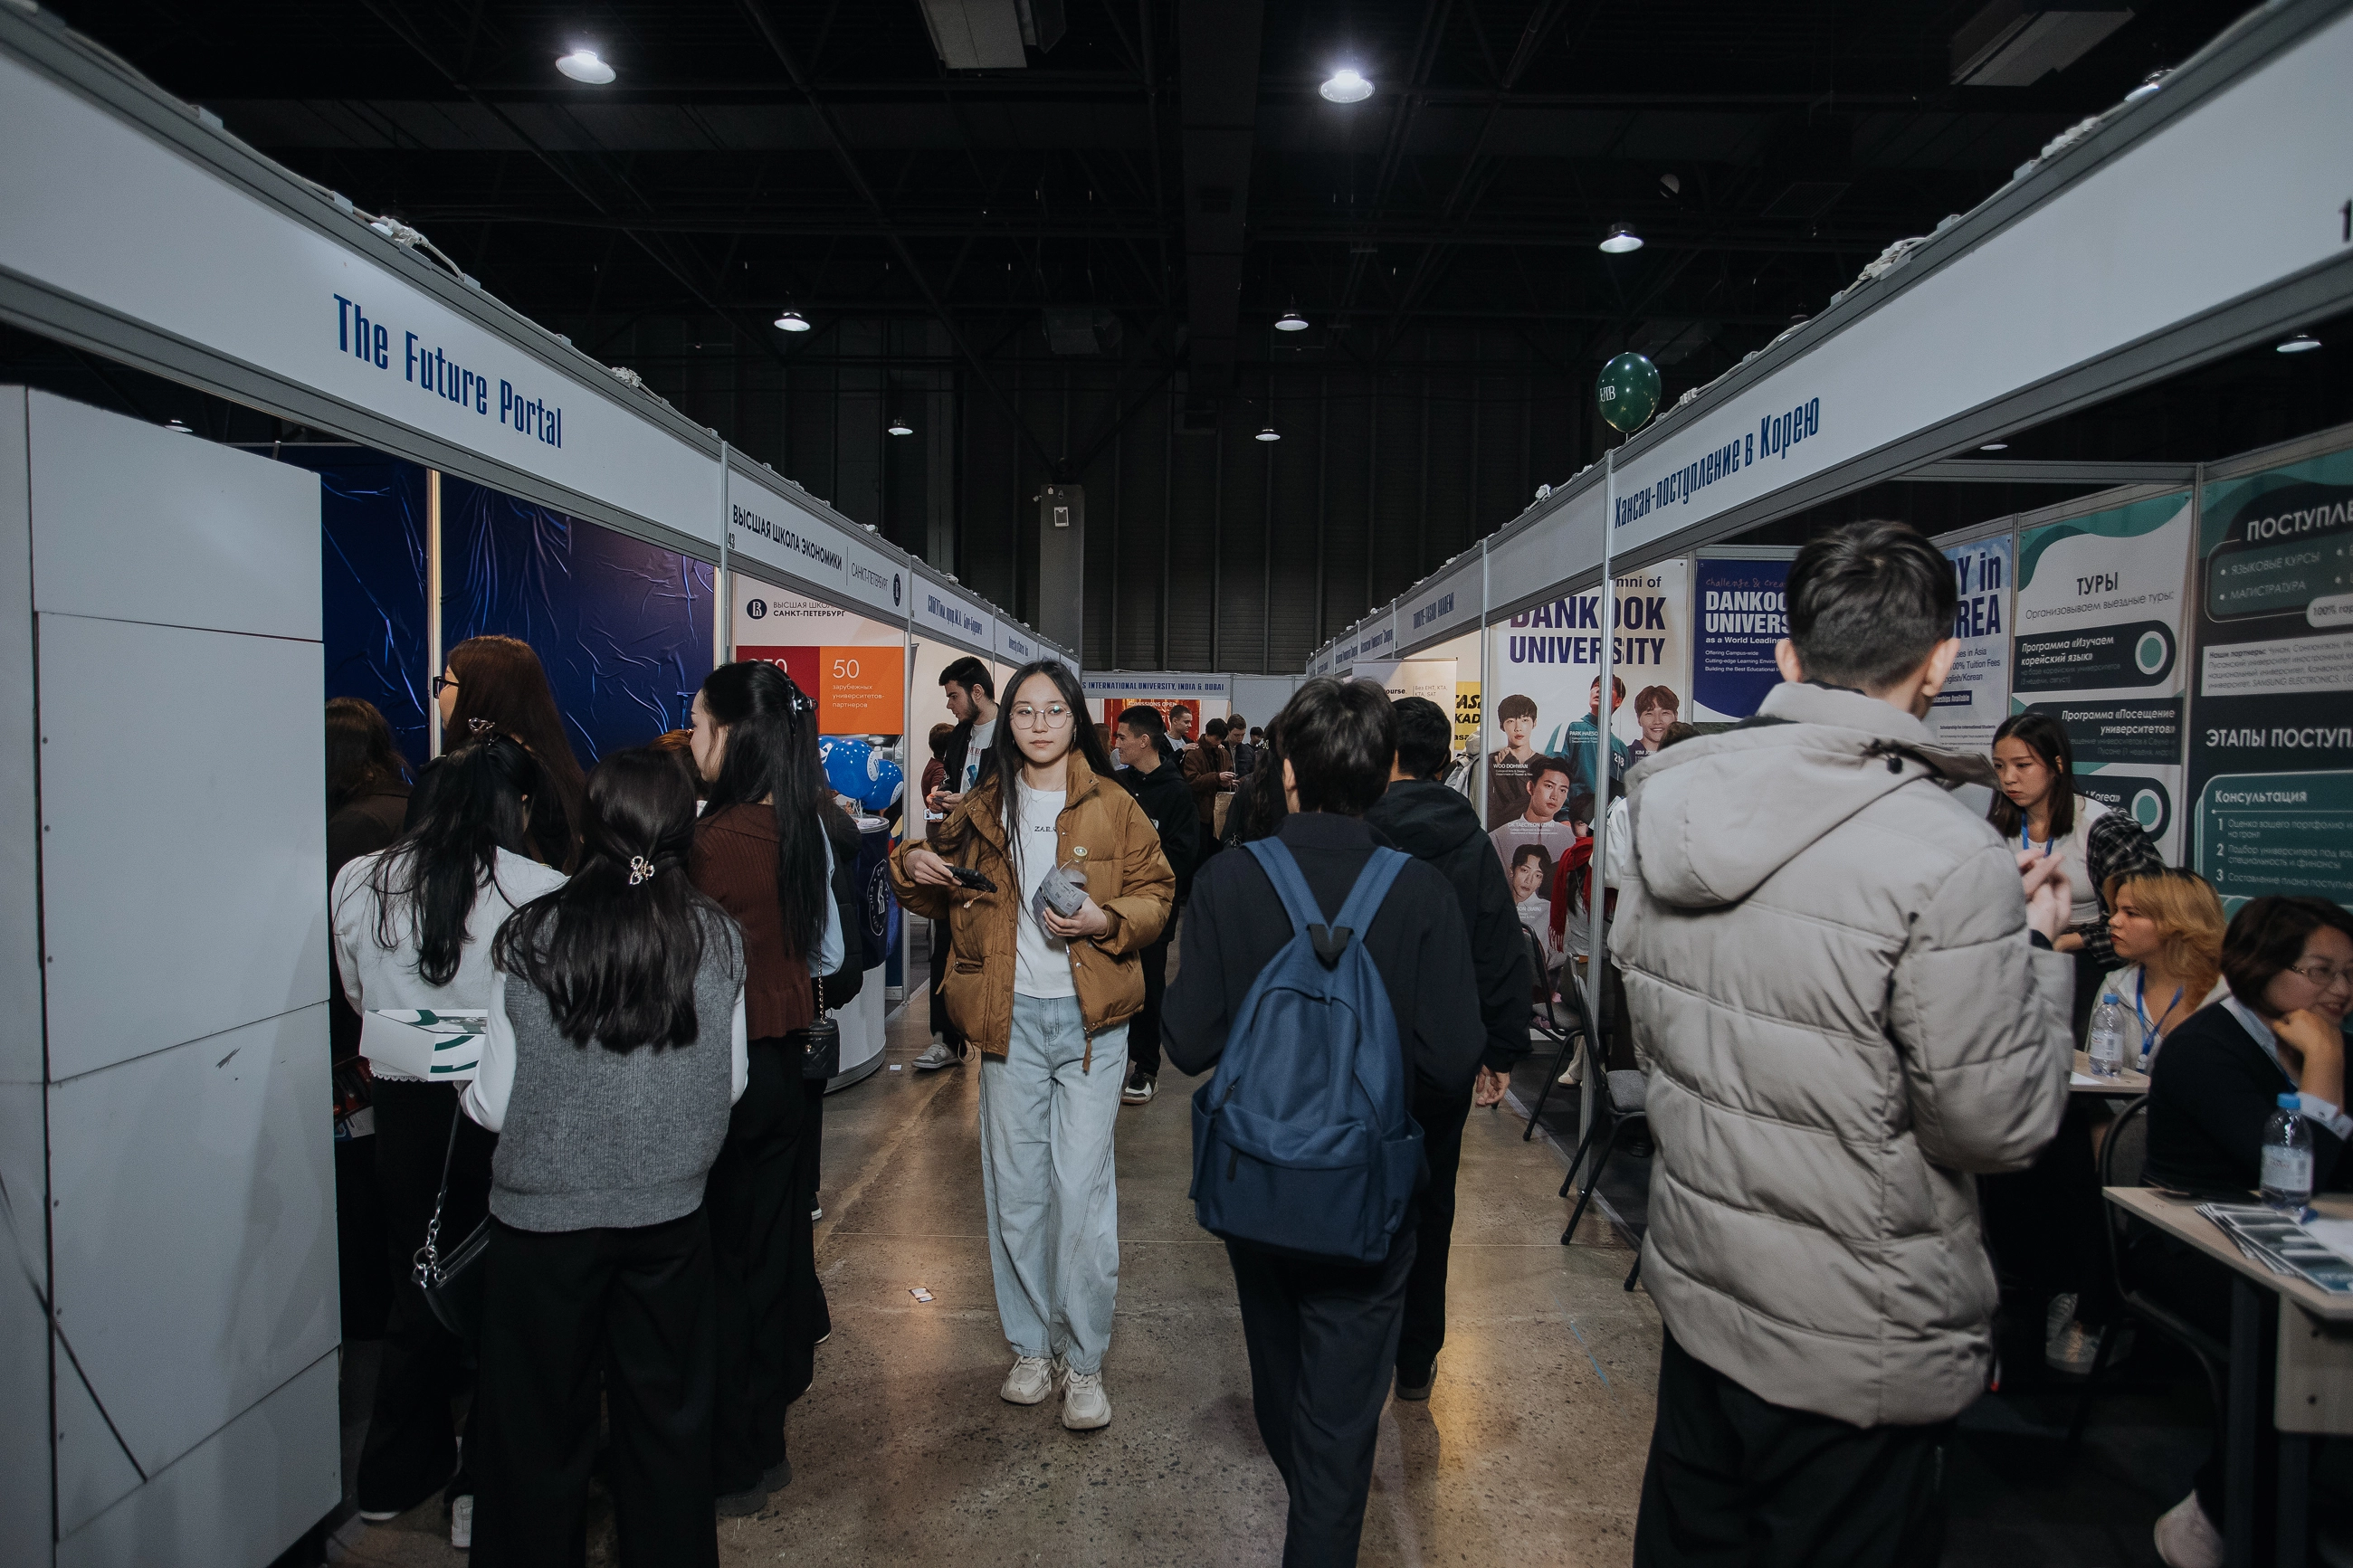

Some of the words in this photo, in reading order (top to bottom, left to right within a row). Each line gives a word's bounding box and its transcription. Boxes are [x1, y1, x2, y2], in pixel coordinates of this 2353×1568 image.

[334, 293, 388, 370] The
[405, 330, 487, 415] Future
[500, 378, 562, 449] Portal
[1615, 439, 1740, 529] Хансан-поступление
[1745, 432, 1753, 468] в
[1760, 396, 1819, 460] Корею
[2247, 500, 2353, 541] ПОСТУПЛЕ
[733, 504, 770, 539] ВЫСШАЯ
[772, 523, 800, 553] ШКОЛА
[802, 537, 843, 572] ЭКОНОМИКИ
[851, 562, 890, 591] САНКТ-ПЕТЕРБУРГ
[1979, 552, 2001, 593] in
[1616, 576, 1643, 588] mni
[1647, 576, 1662, 588] of
[1706, 578, 1750, 589] challenge
[1752, 578, 1760, 588] &
[1764, 580, 1786, 588] crea
[2077, 572, 2119, 595] ТУРЫ
[1706, 592, 1786, 612] DANKOO
[2025, 603, 2101, 620] Организовываем
[2103, 595, 2146, 610] выездные
[1706, 613, 1790, 633] UNIVERS
[1956, 594, 2001, 639] REA
[1967, 649, 1973, 657] in
[1974, 648, 1986, 656] Asia
[2022, 641, 2071, 654] Программа
[2072, 636, 2114, 649] «Изучаем
[1967, 660, 1986, 670] Tuition
[2021, 652, 2066, 668] корейский
[2067, 652, 2093, 662] язык»
[833, 660, 860, 679] 50
[1138, 682, 1176, 691] UNIVERSITY,
[2062, 710, 2114, 721] Программа
[2116, 709, 2175, 719] «Посещение
[2205, 728, 2266, 747] ЭТАПЫ
[2271, 728, 2353, 748] ПОСТУП
[2215, 790, 2307, 805] Консультация
[2218, 818, 2224, 831] 1
[2216, 843, 2224, 856] 2
[2216, 869, 2224, 881] 3
